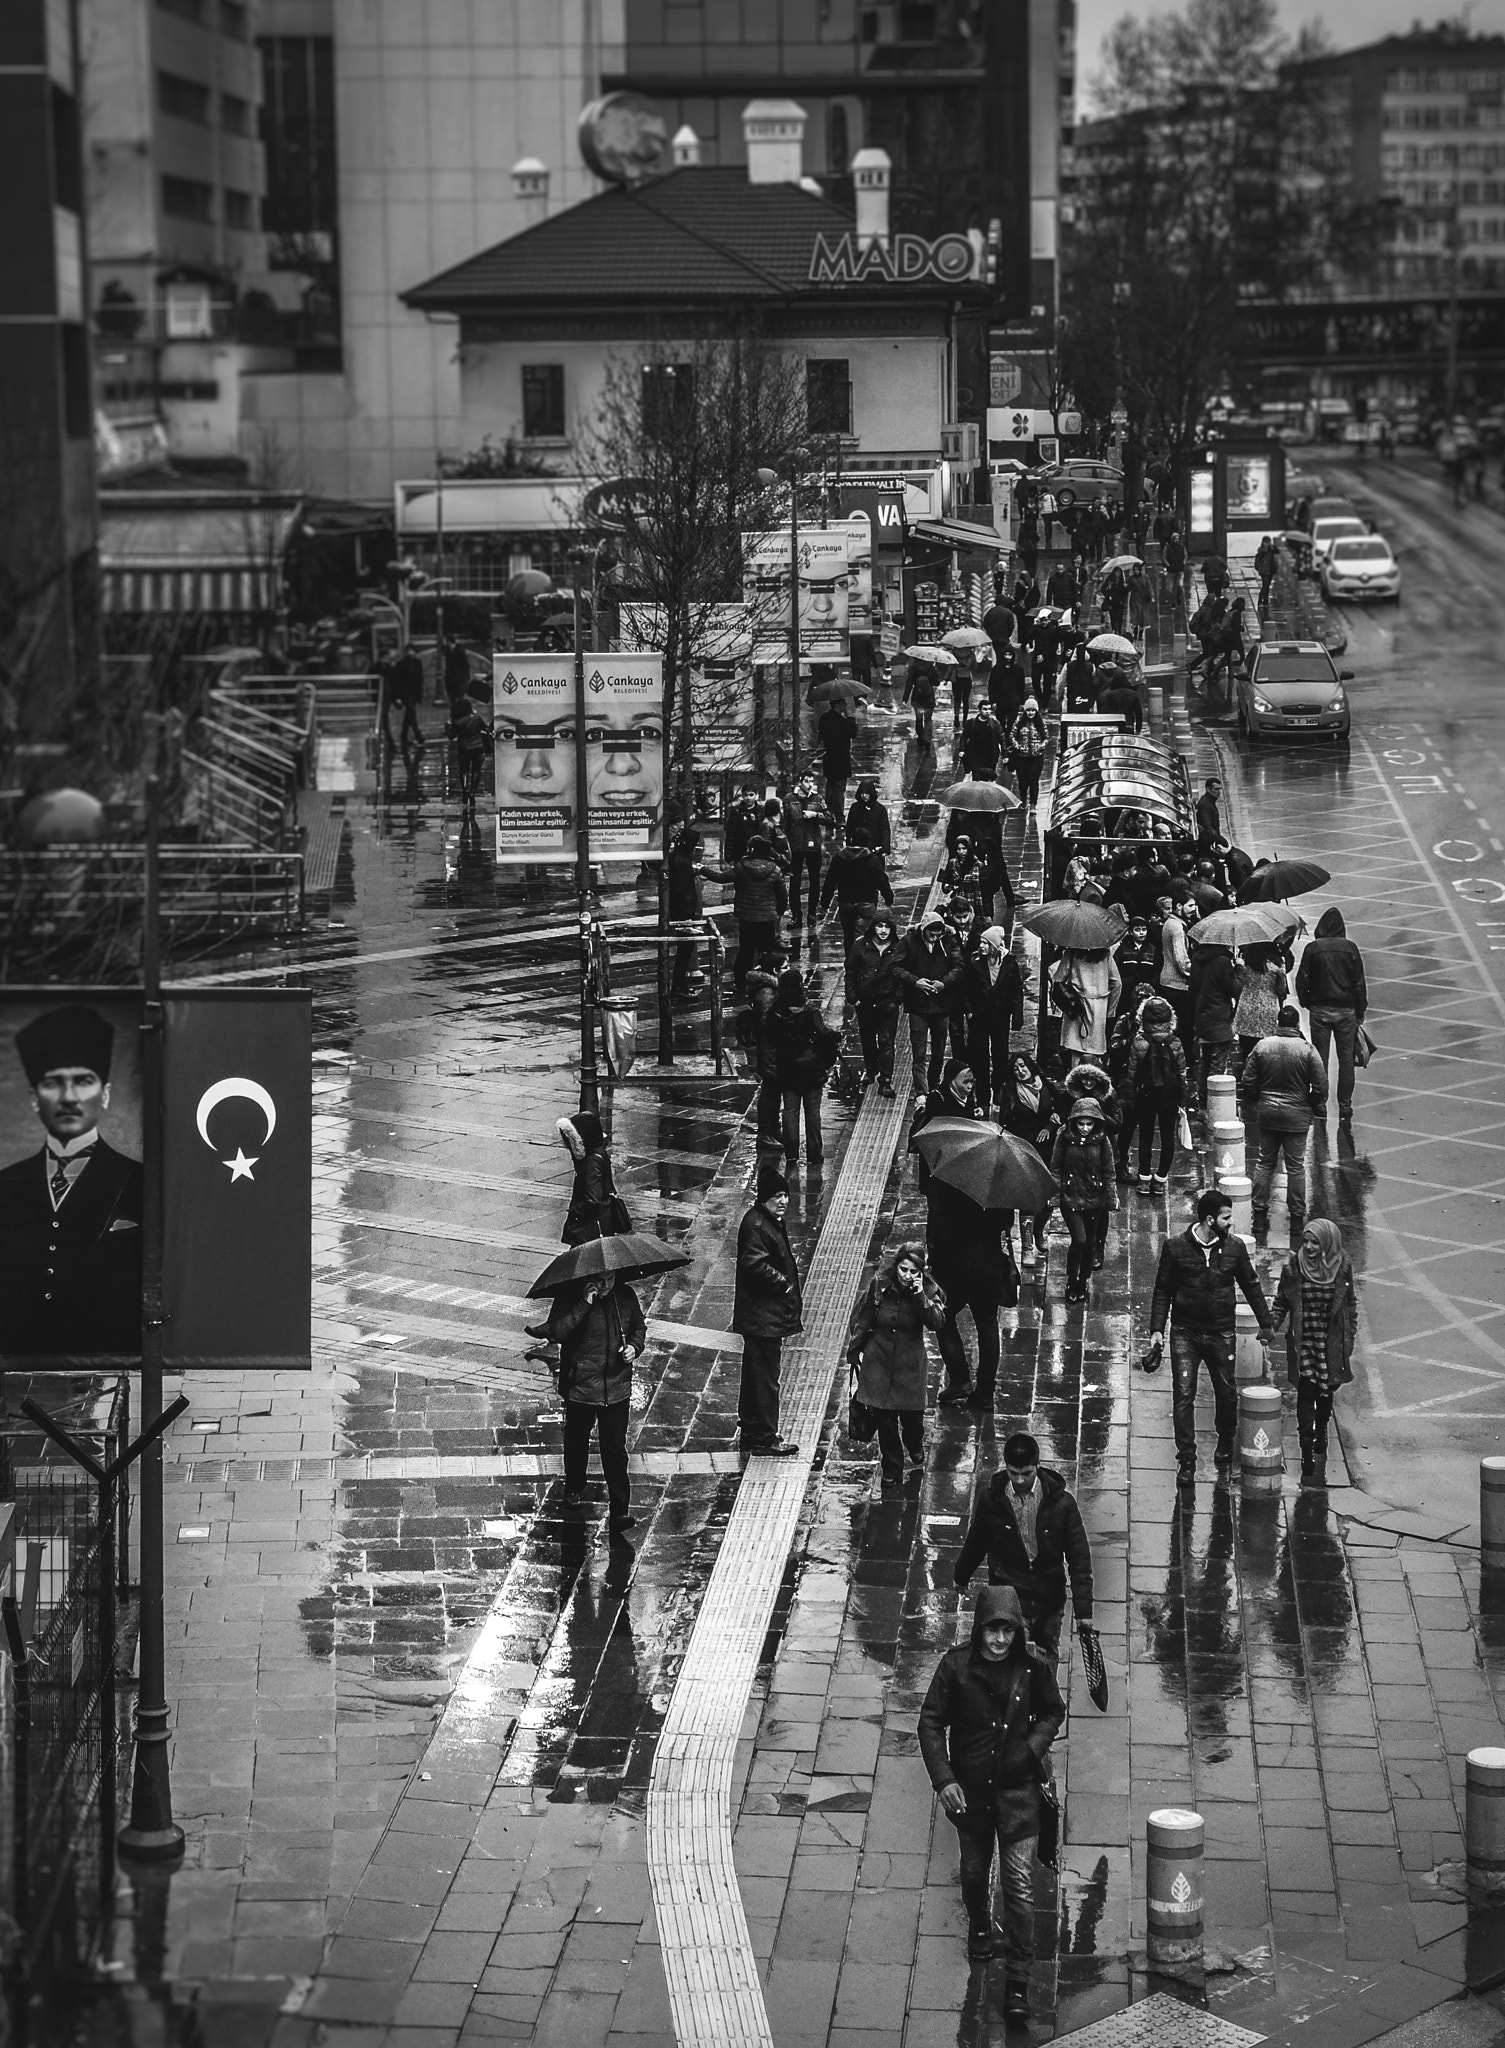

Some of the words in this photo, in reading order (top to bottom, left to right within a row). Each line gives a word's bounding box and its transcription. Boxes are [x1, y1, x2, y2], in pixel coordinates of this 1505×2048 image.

[808, 231, 977, 282] MADO
[520, 677, 567, 688] Çankaya
[607, 676, 653, 687] Çankaya
[501, 810, 522, 818] Kadın
[522, 811, 539, 819] veya
[540, 810, 563, 818] erkek,
[608, 811, 625, 819] veya
[501, 819, 516, 827] tüm
[516, 819, 546, 827] insanlar
[546, 818, 570, 827] eşittir.
[602, 818, 632, 826] insanlar
[632, 818, 656, 826] eşittir.
